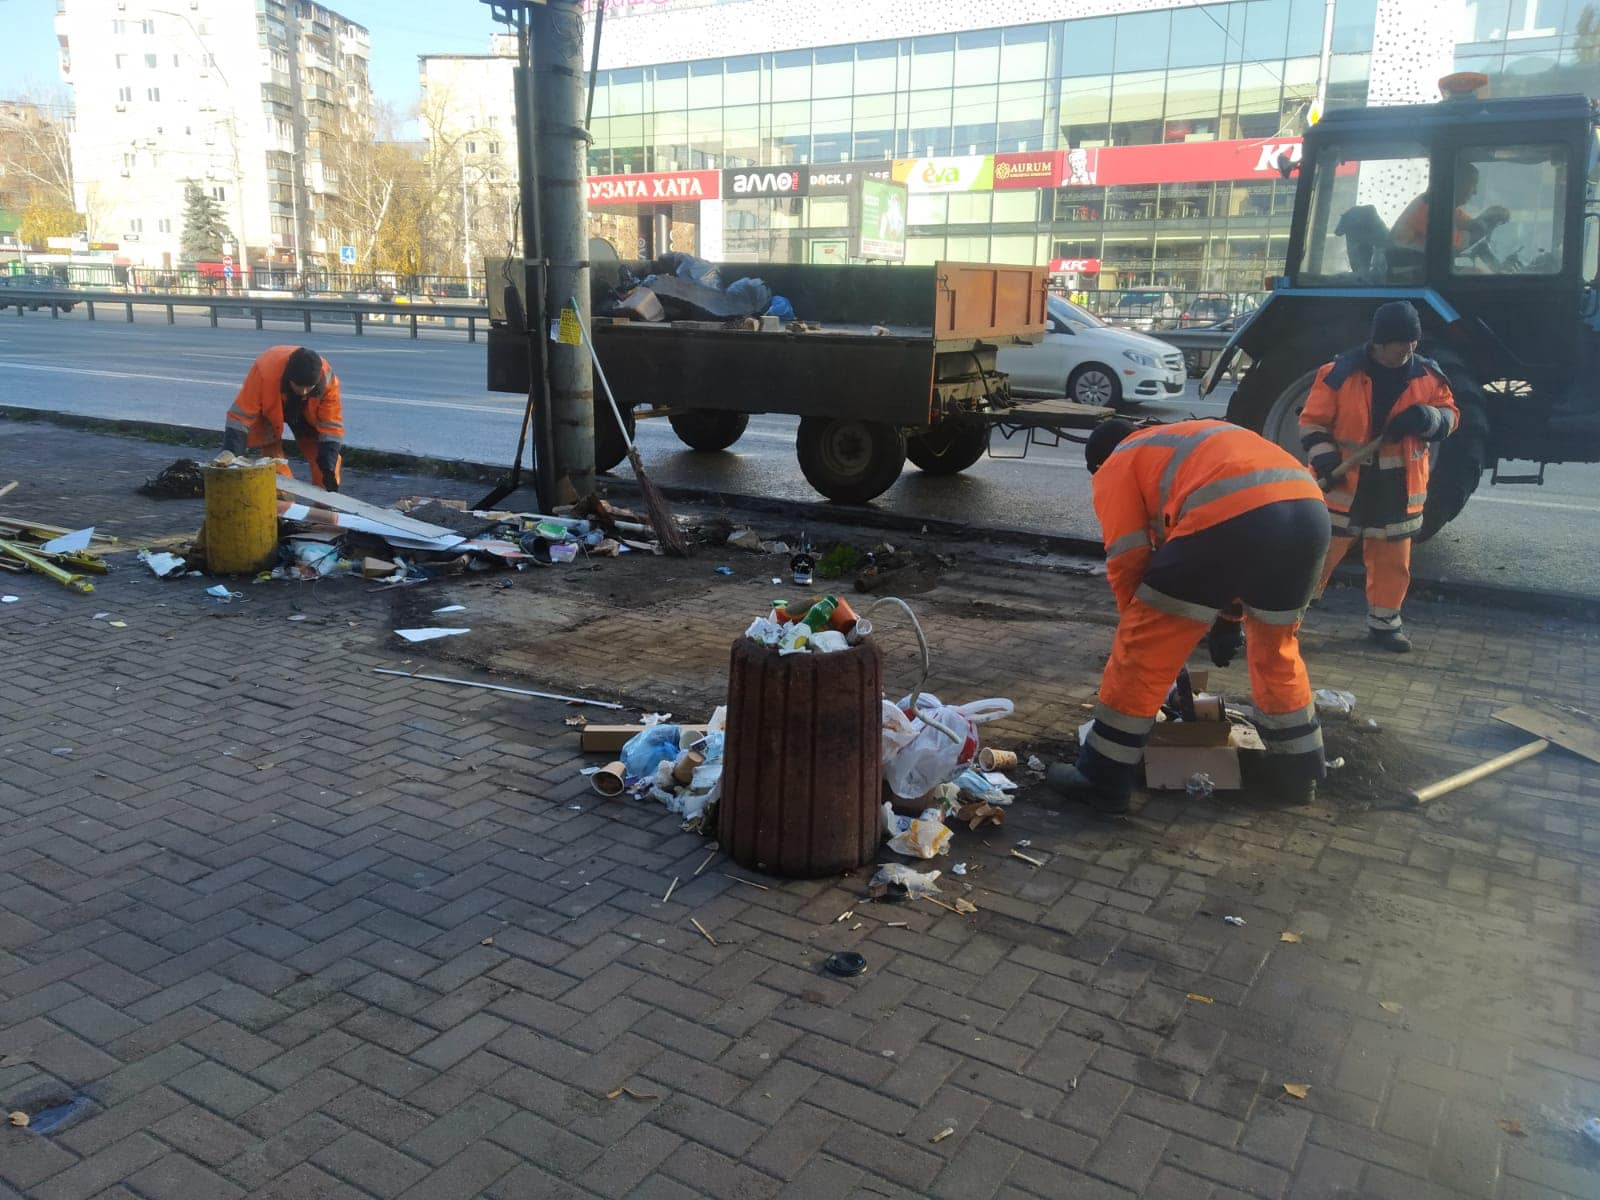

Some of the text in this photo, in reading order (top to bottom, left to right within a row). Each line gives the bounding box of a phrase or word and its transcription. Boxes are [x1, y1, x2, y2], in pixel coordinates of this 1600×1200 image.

[1010, 162, 1052, 173] AURUM
[652, 177, 704, 197] ХАТА
[1060, 260, 1089, 271] KFC
